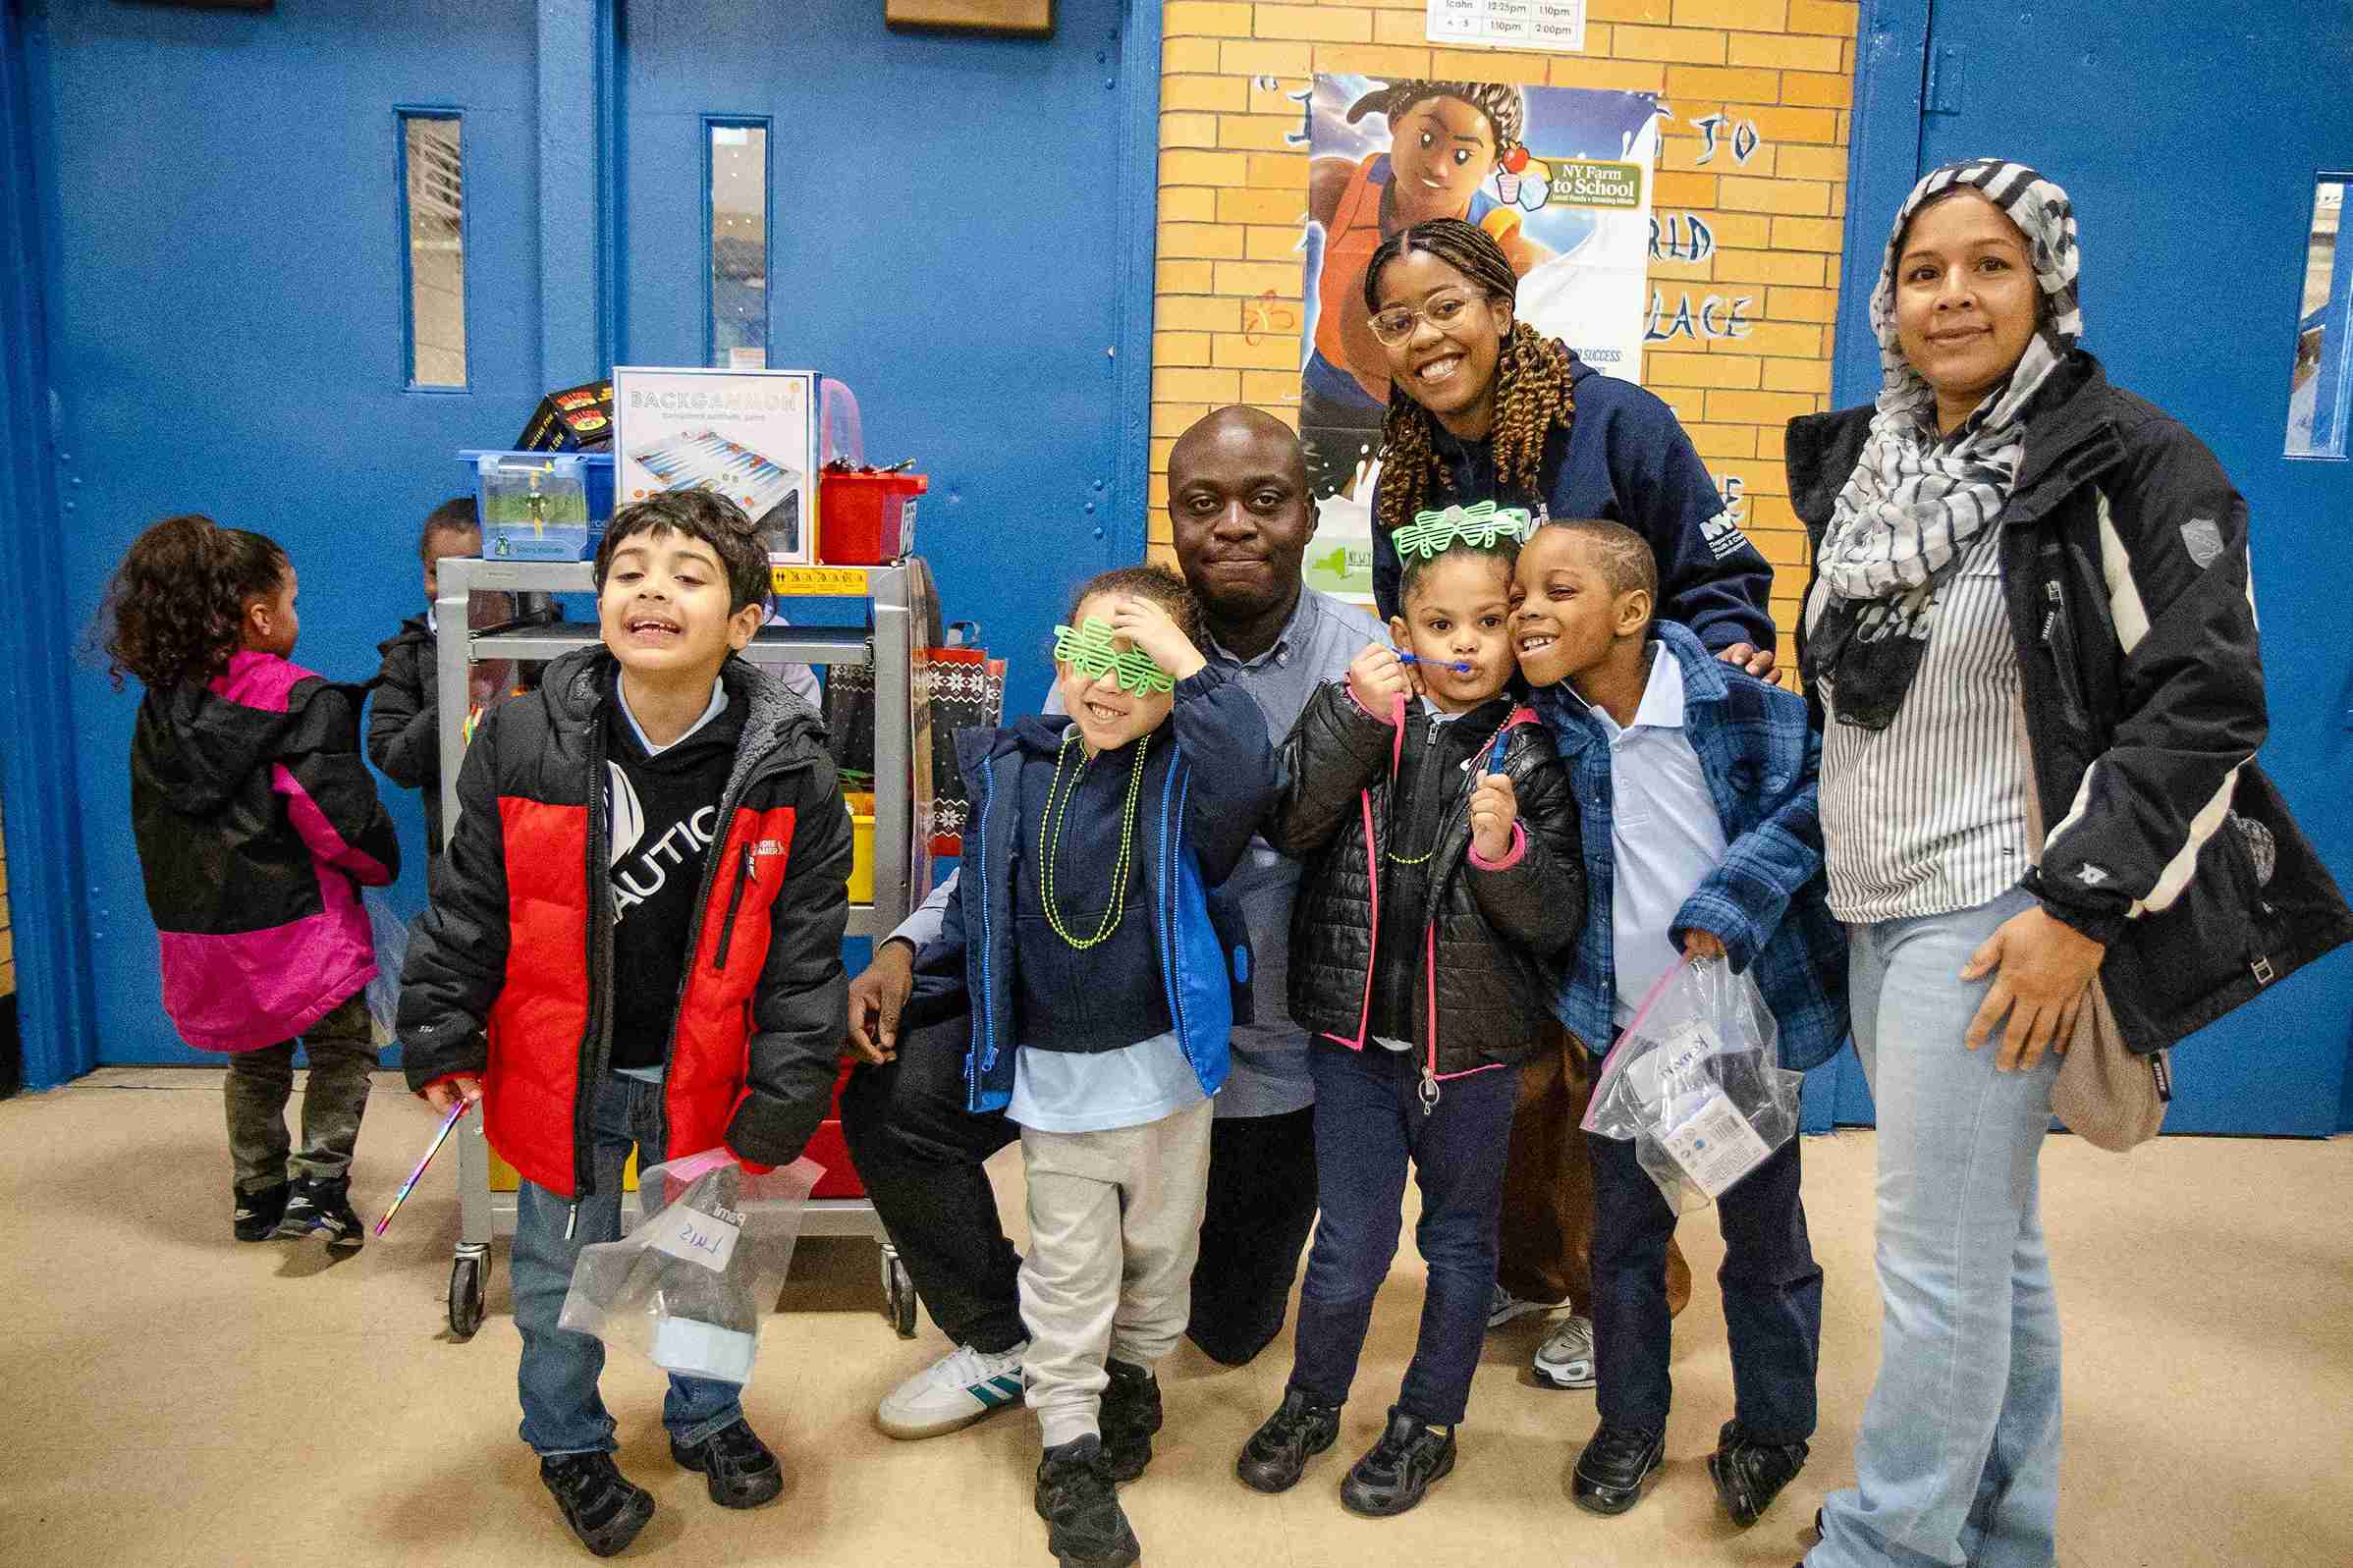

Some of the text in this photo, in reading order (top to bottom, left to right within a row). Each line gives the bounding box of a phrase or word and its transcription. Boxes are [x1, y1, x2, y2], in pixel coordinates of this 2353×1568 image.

[1536, 25, 1572, 36] 2:00pm
[1562, 164, 1622, 181] NY Farm
[1553, 178, 1635, 196] to School
[1644, 291, 1755, 341] LACE
[629, 391, 798, 412] BACKGAMMON
[613, 804, 715, 925] AUTIC
